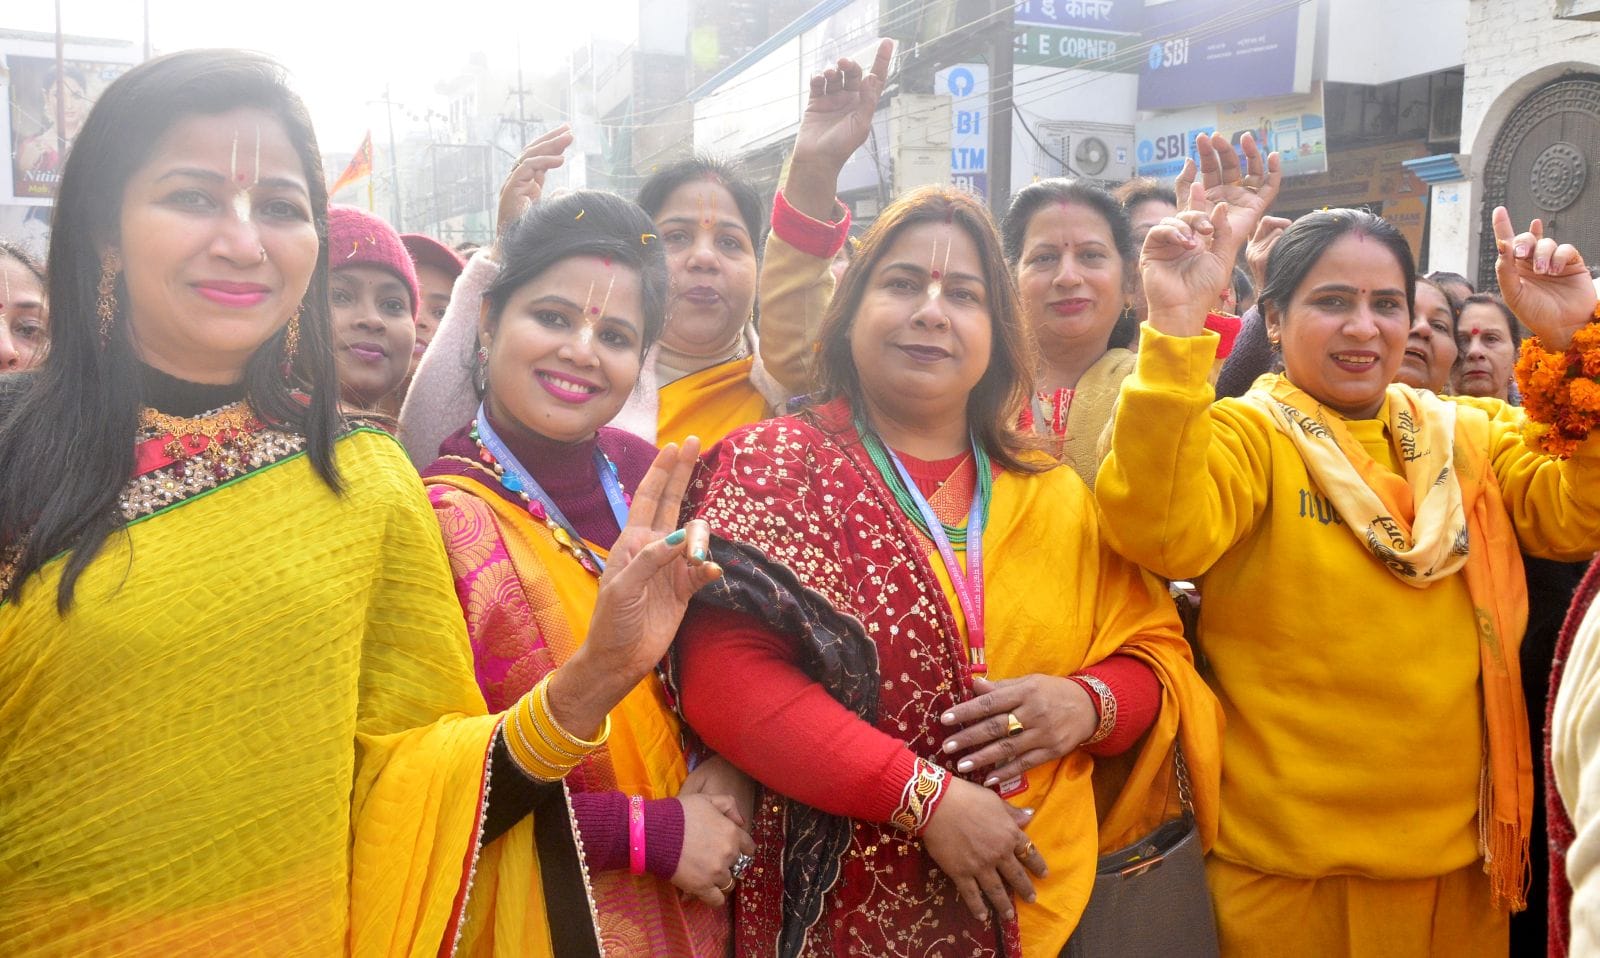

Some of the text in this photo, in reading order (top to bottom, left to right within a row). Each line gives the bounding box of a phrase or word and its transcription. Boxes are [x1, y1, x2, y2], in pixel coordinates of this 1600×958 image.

[1163, 38, 1189, 67] SBI
[952, 111, 980, 135] BI
[1156, 133, 1185, 160] SBI
